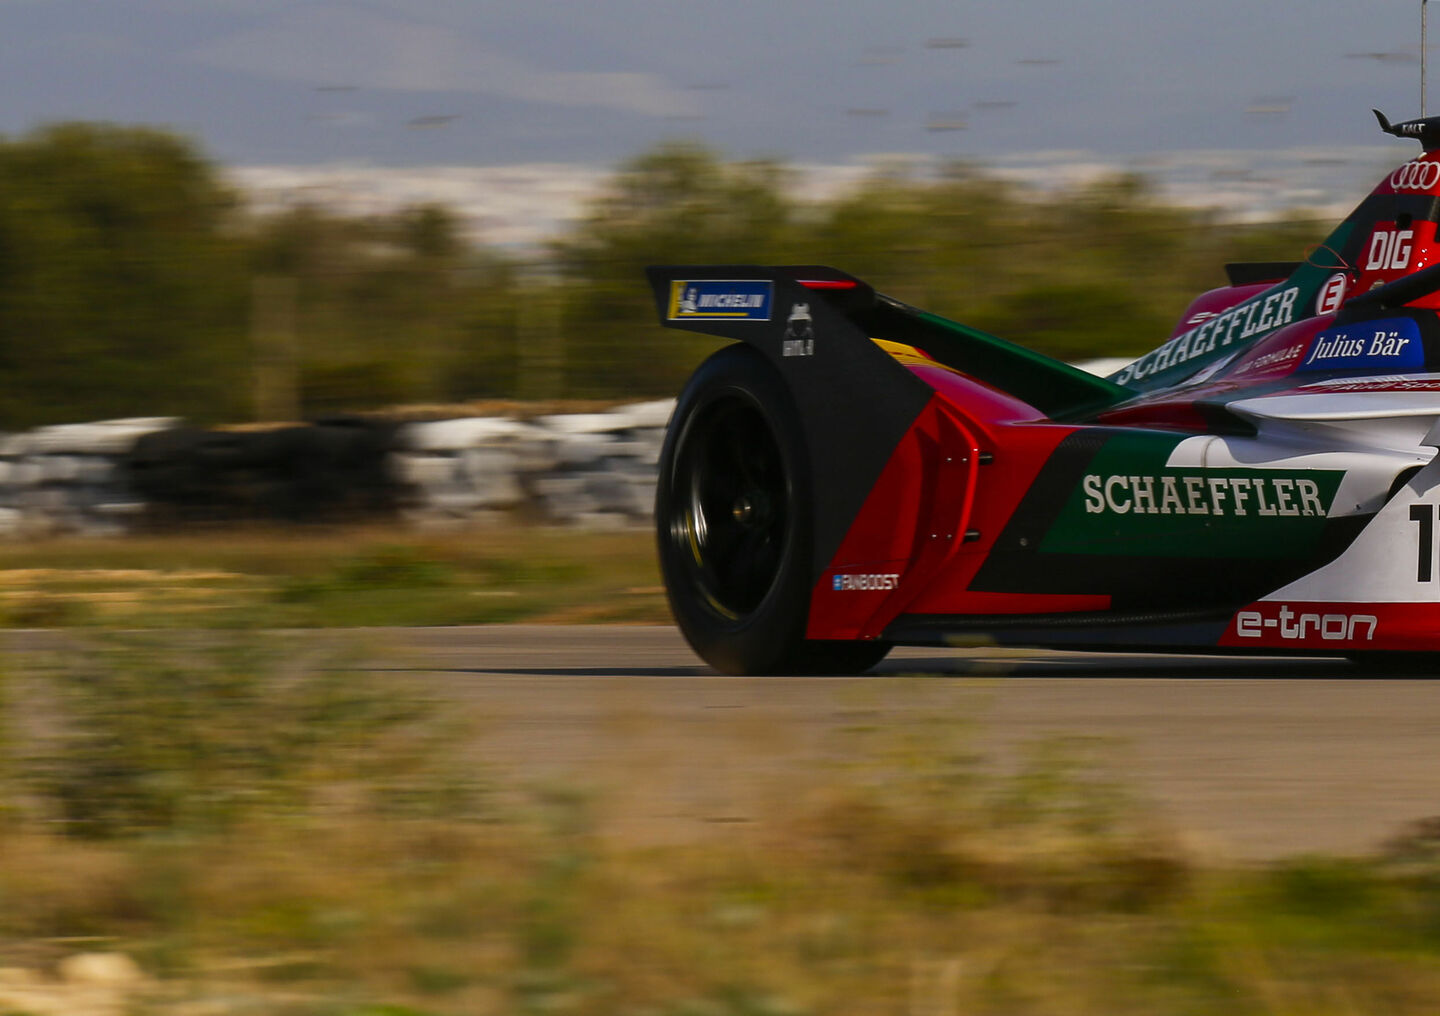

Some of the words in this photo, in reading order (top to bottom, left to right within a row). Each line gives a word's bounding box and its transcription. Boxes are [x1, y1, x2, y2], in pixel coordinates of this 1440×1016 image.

[1365, 230, 1414, 271] DIG
[697, 293, 765, 308] MICHELIN
[1306, 335, 1364, 365] Julius
[1366, 331, 1410, 356] Bär
[1082, 474, 1326, 517] SCHAEFFLER
[1236, 605, 1378, 641] e-tron
